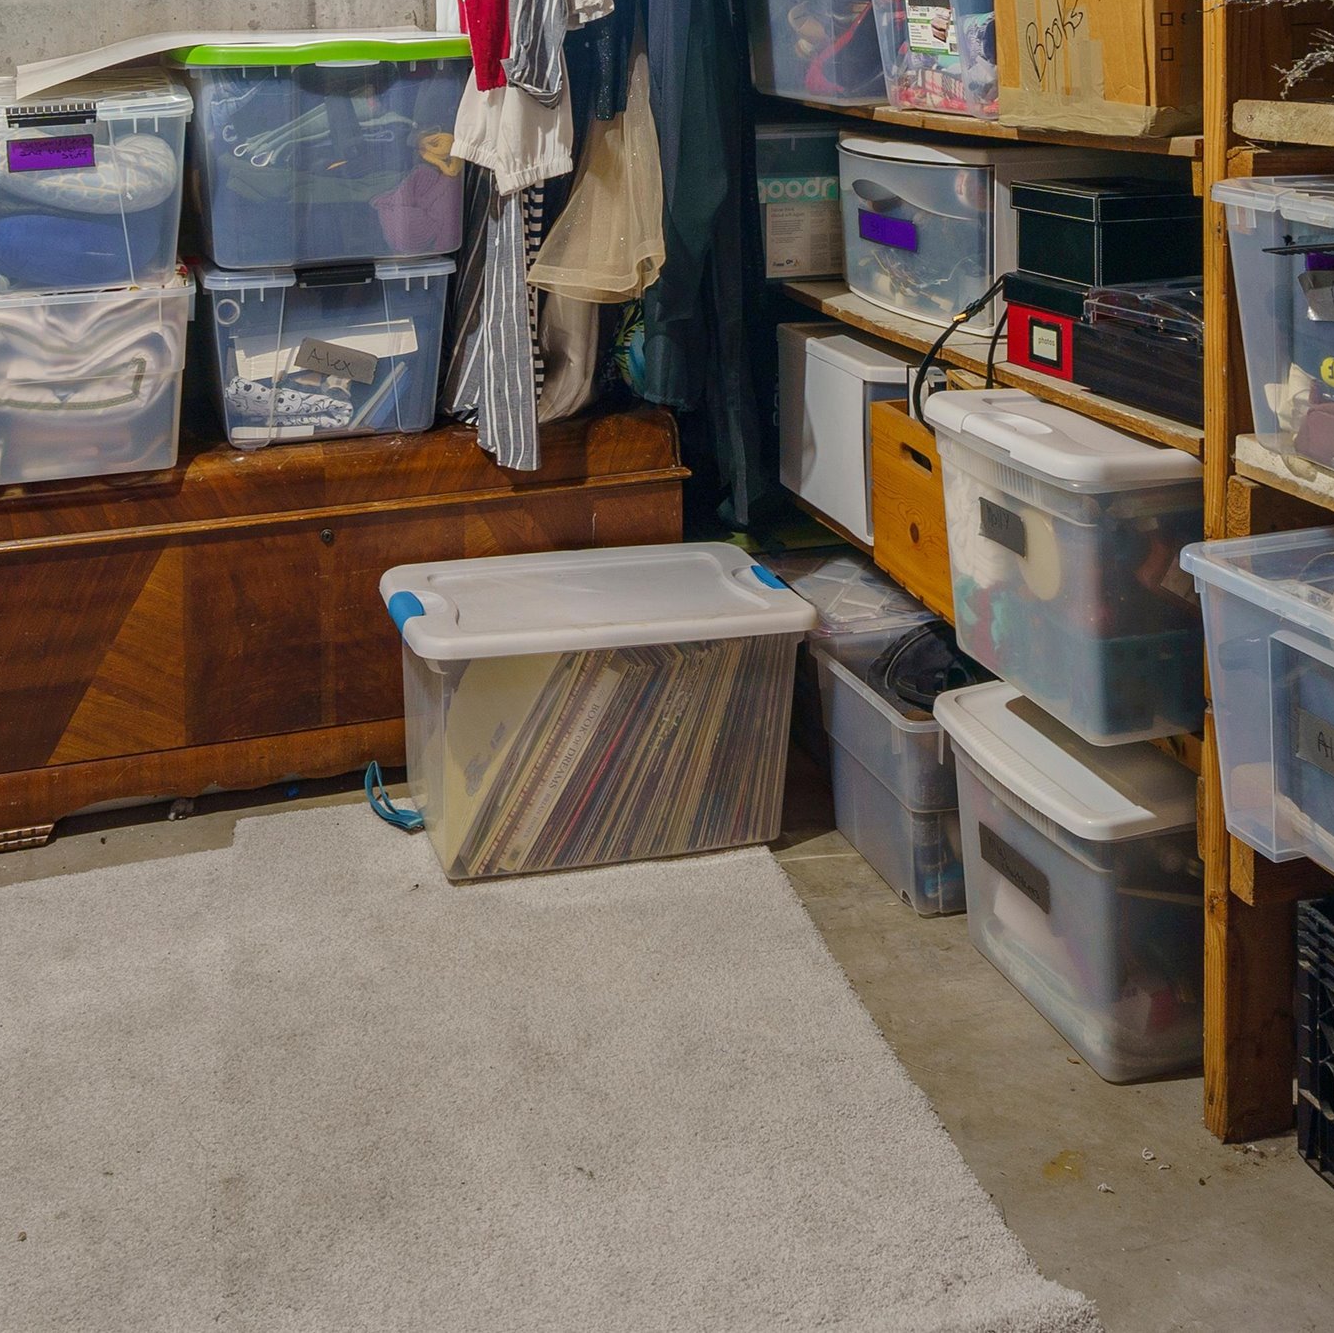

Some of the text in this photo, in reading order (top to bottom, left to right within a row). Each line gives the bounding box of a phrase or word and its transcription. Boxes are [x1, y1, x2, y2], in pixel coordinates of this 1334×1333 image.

[1037, 335, 1056, 347] photos
[548, 704, 601, 790] BOOK DREAMS
